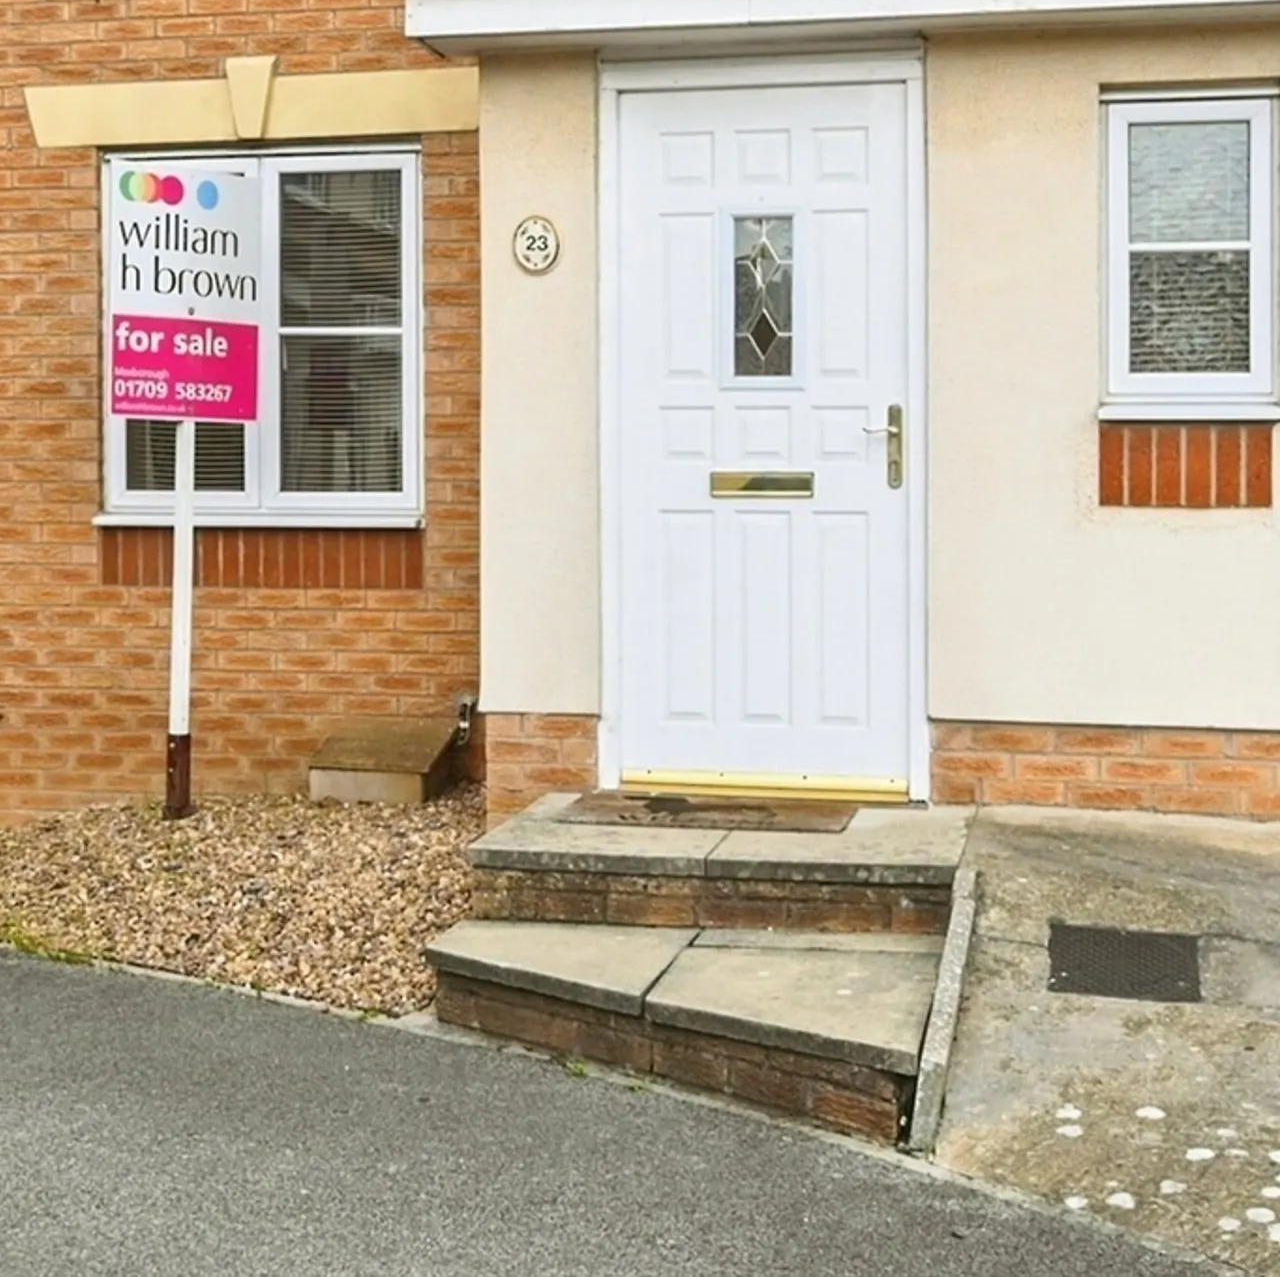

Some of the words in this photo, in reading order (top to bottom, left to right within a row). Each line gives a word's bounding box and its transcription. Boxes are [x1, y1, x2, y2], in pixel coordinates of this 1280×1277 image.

[119, 212, 239, 258] william
[525, 234, 549, 252] 23
[122, 252, 141, 291] h
[154, 254, 257, 302] brown
[115, 320, 165, 353] for
[172, 327, 228, 358] sale
[114, 378, 168, 399] 01709
[174, 382, 233, 403] 583267
